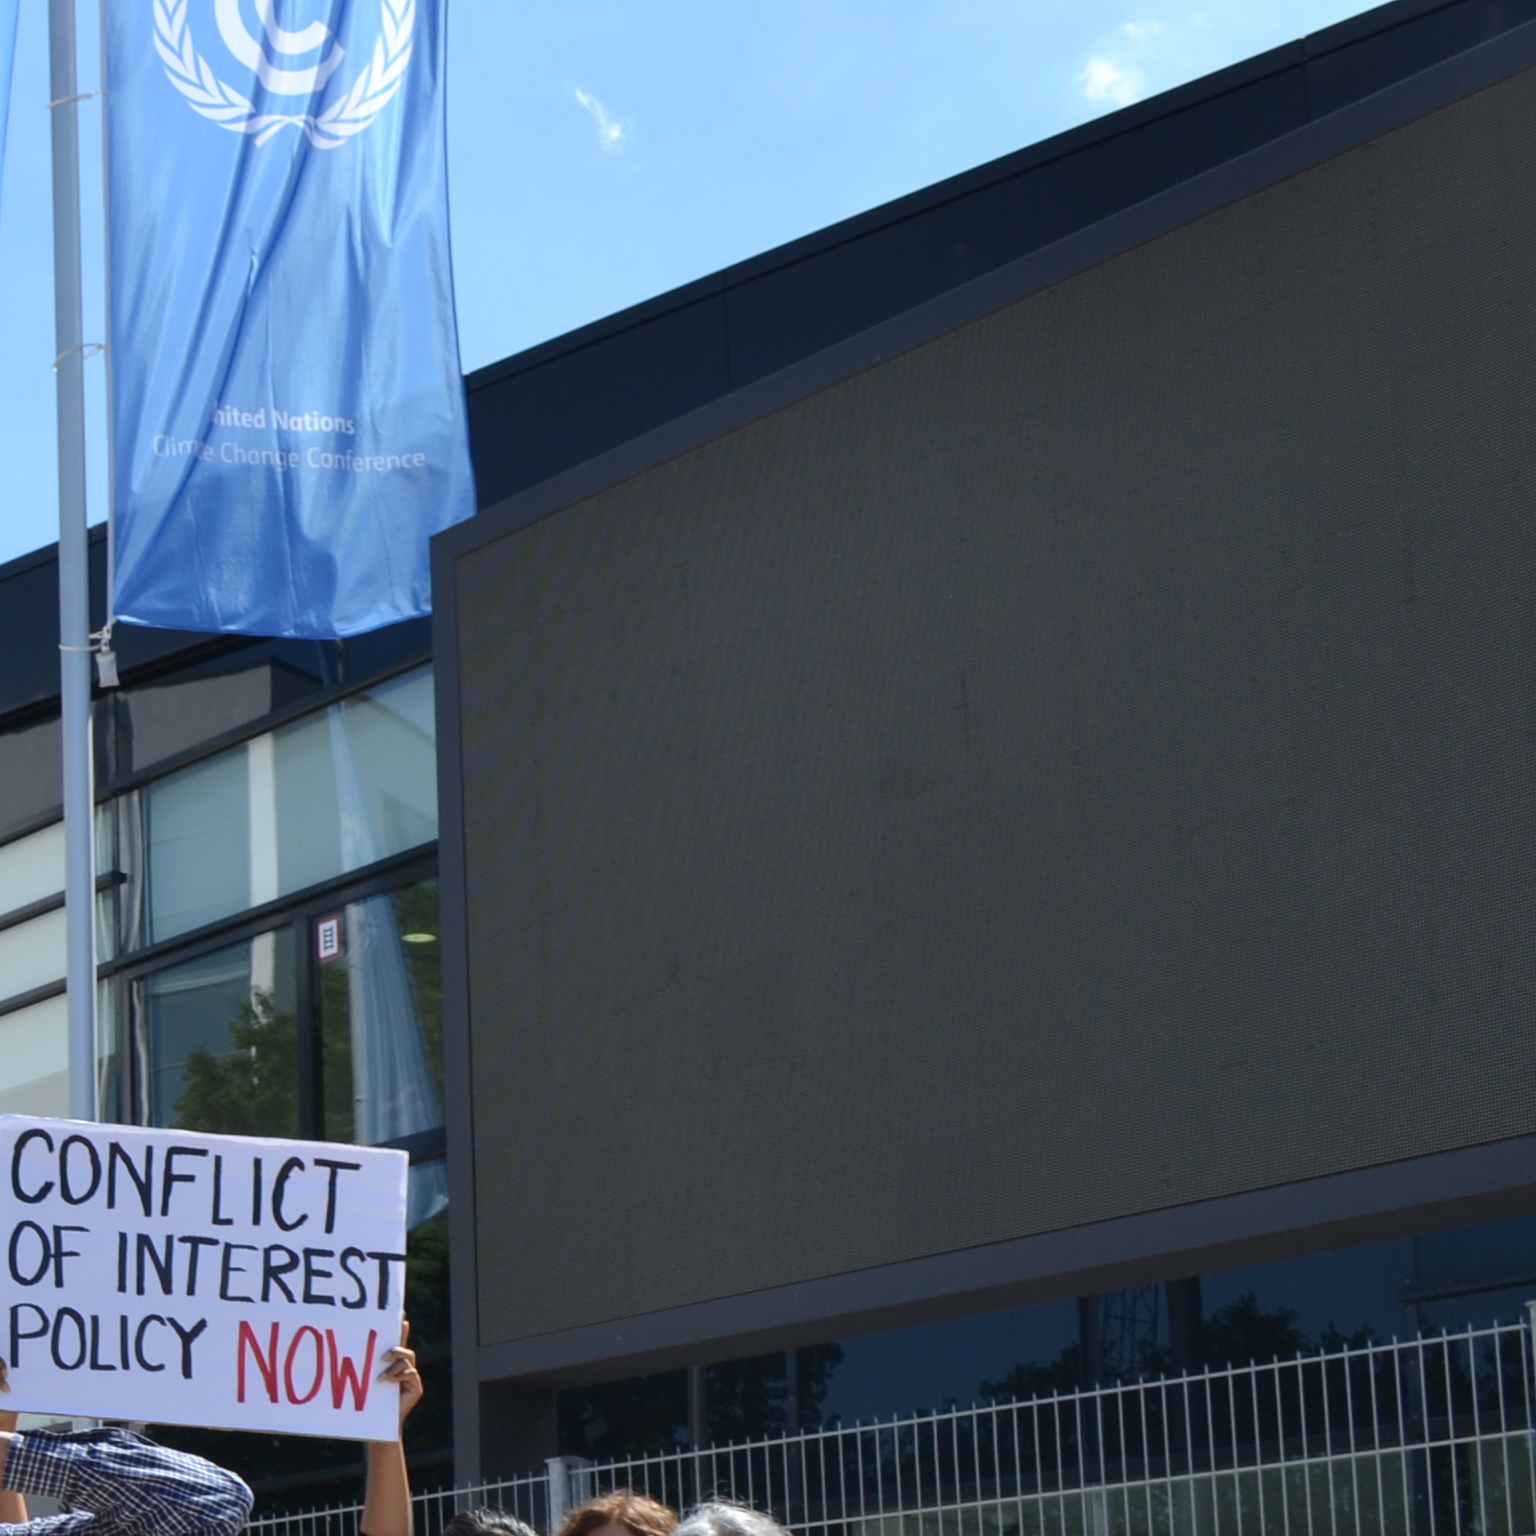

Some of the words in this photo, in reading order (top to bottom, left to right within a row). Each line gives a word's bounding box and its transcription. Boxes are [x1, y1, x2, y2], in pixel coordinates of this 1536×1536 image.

[213, 405, 266, 430] nited
[273, 409, 356, 436] Nations
[220, 443, 299, 473] Change
[306, 447, 427, 473] Conference
[11, 1128, 362, 1235] CONFLICT
[8, 1220, 91, 1288] OF
[117, 1231, 407, 1310] INTEREST
[9, 1303, 208, 1380] POLICY
[236, 1320, 378, 1412] NOW
